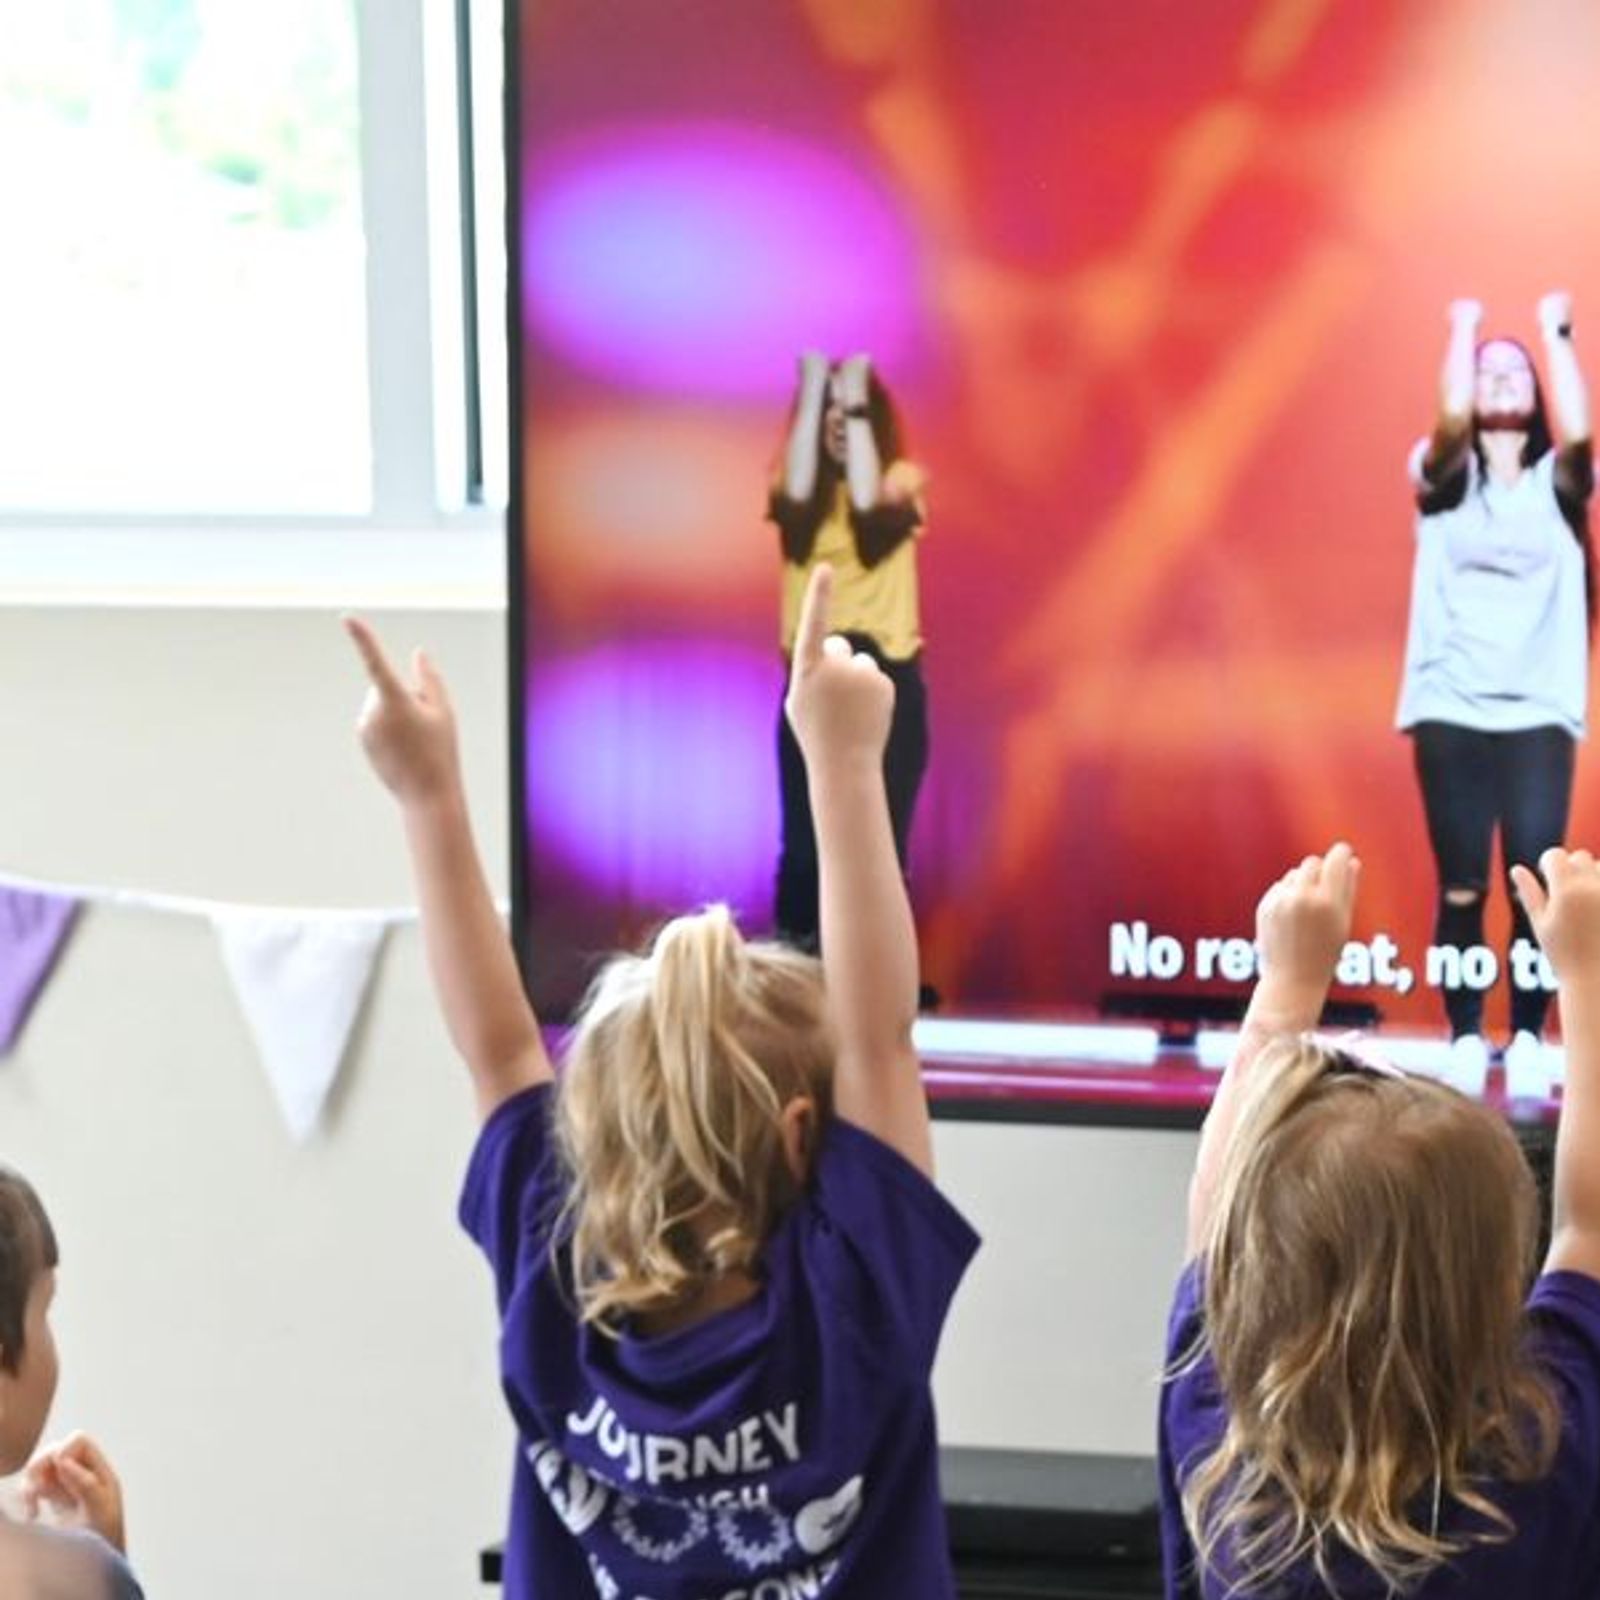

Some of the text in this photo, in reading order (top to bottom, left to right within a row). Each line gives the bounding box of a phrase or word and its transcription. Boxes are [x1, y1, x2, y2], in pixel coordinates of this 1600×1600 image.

[1110, 920, 1184, 979] No
[1195, 933, 1413, 994] reat,
[1425, 944, 1499, 989] no
